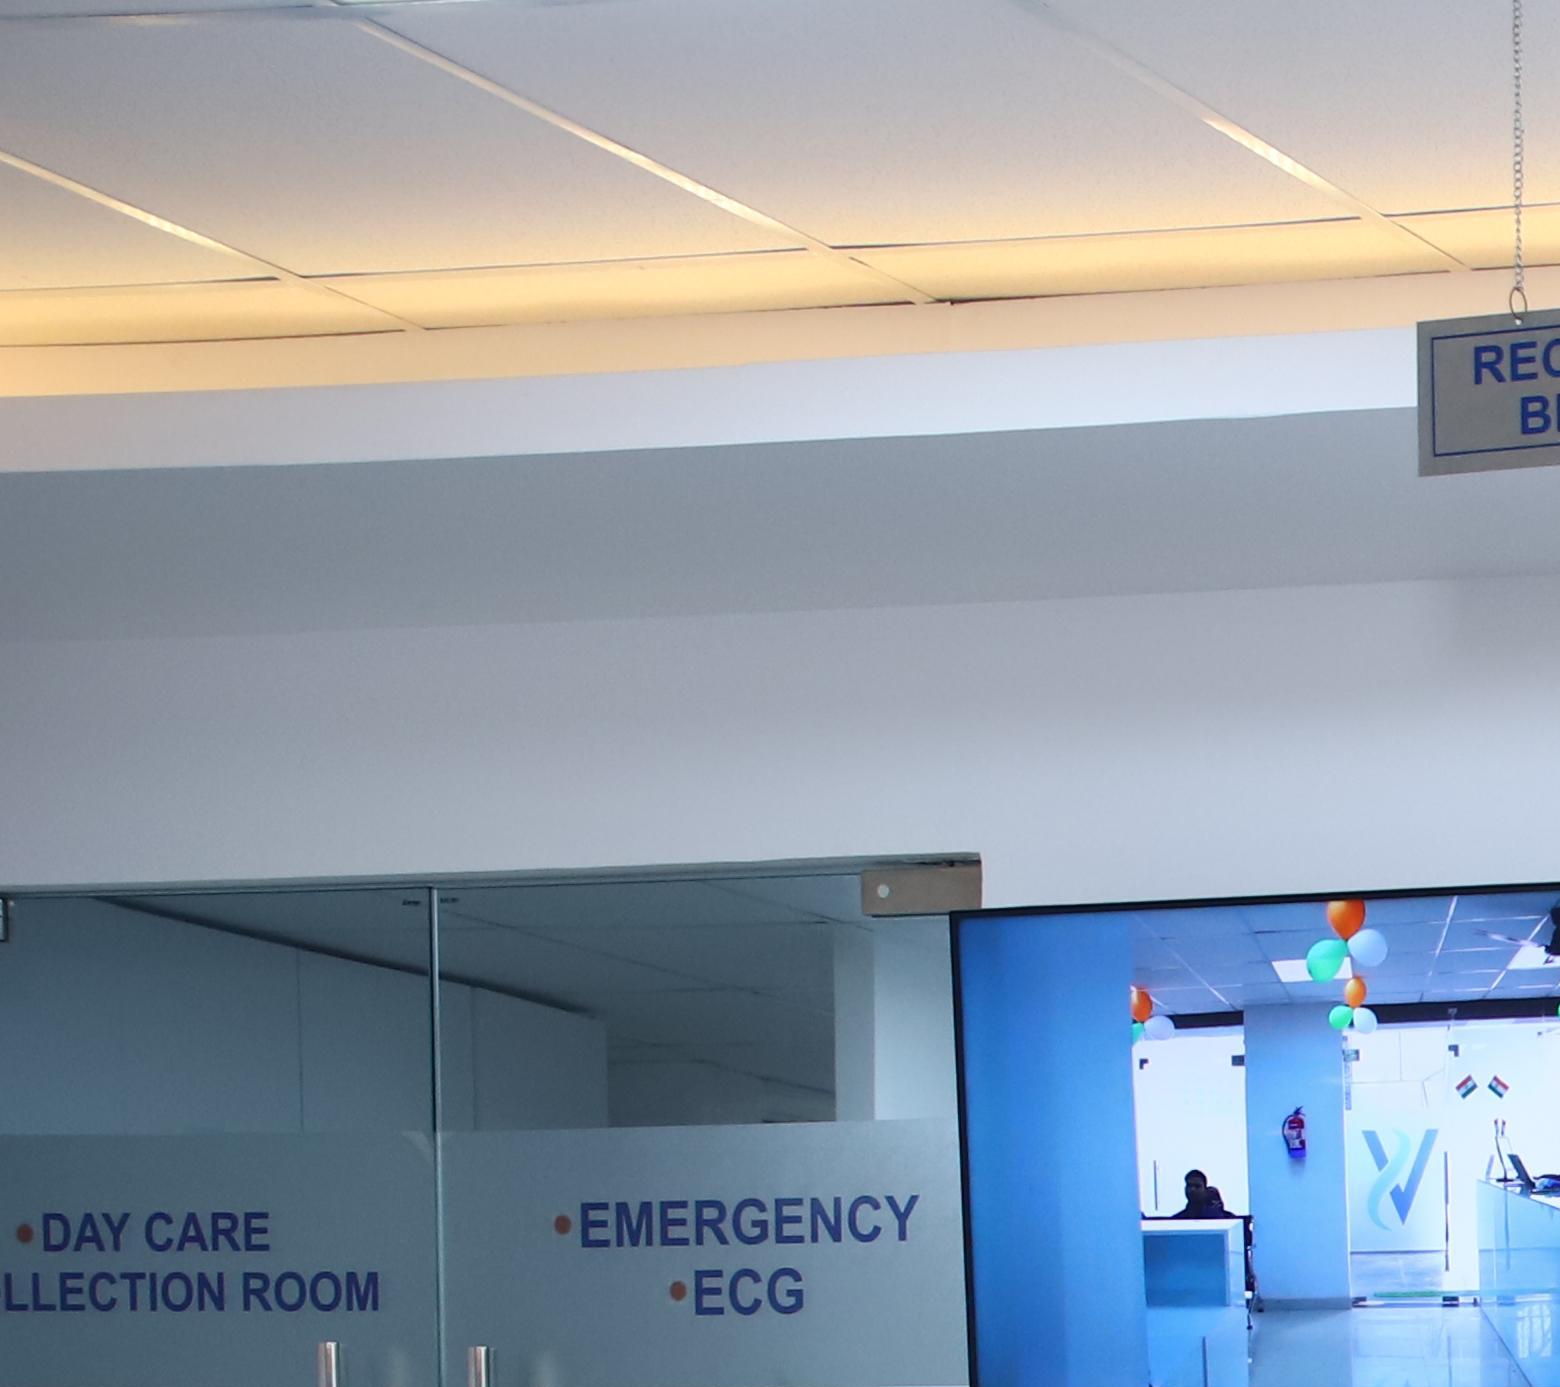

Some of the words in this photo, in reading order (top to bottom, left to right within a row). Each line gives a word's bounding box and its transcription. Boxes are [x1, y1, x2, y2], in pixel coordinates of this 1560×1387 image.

[42, 1212, 131, 1252] DAY
[144, 1211, 270, 1253] CARE
[580, 1194, 920, 1249] EMERGENCY
[242, 1271, 380, 1312] ROOM
[694, 1267, 805, 1316] ECG
